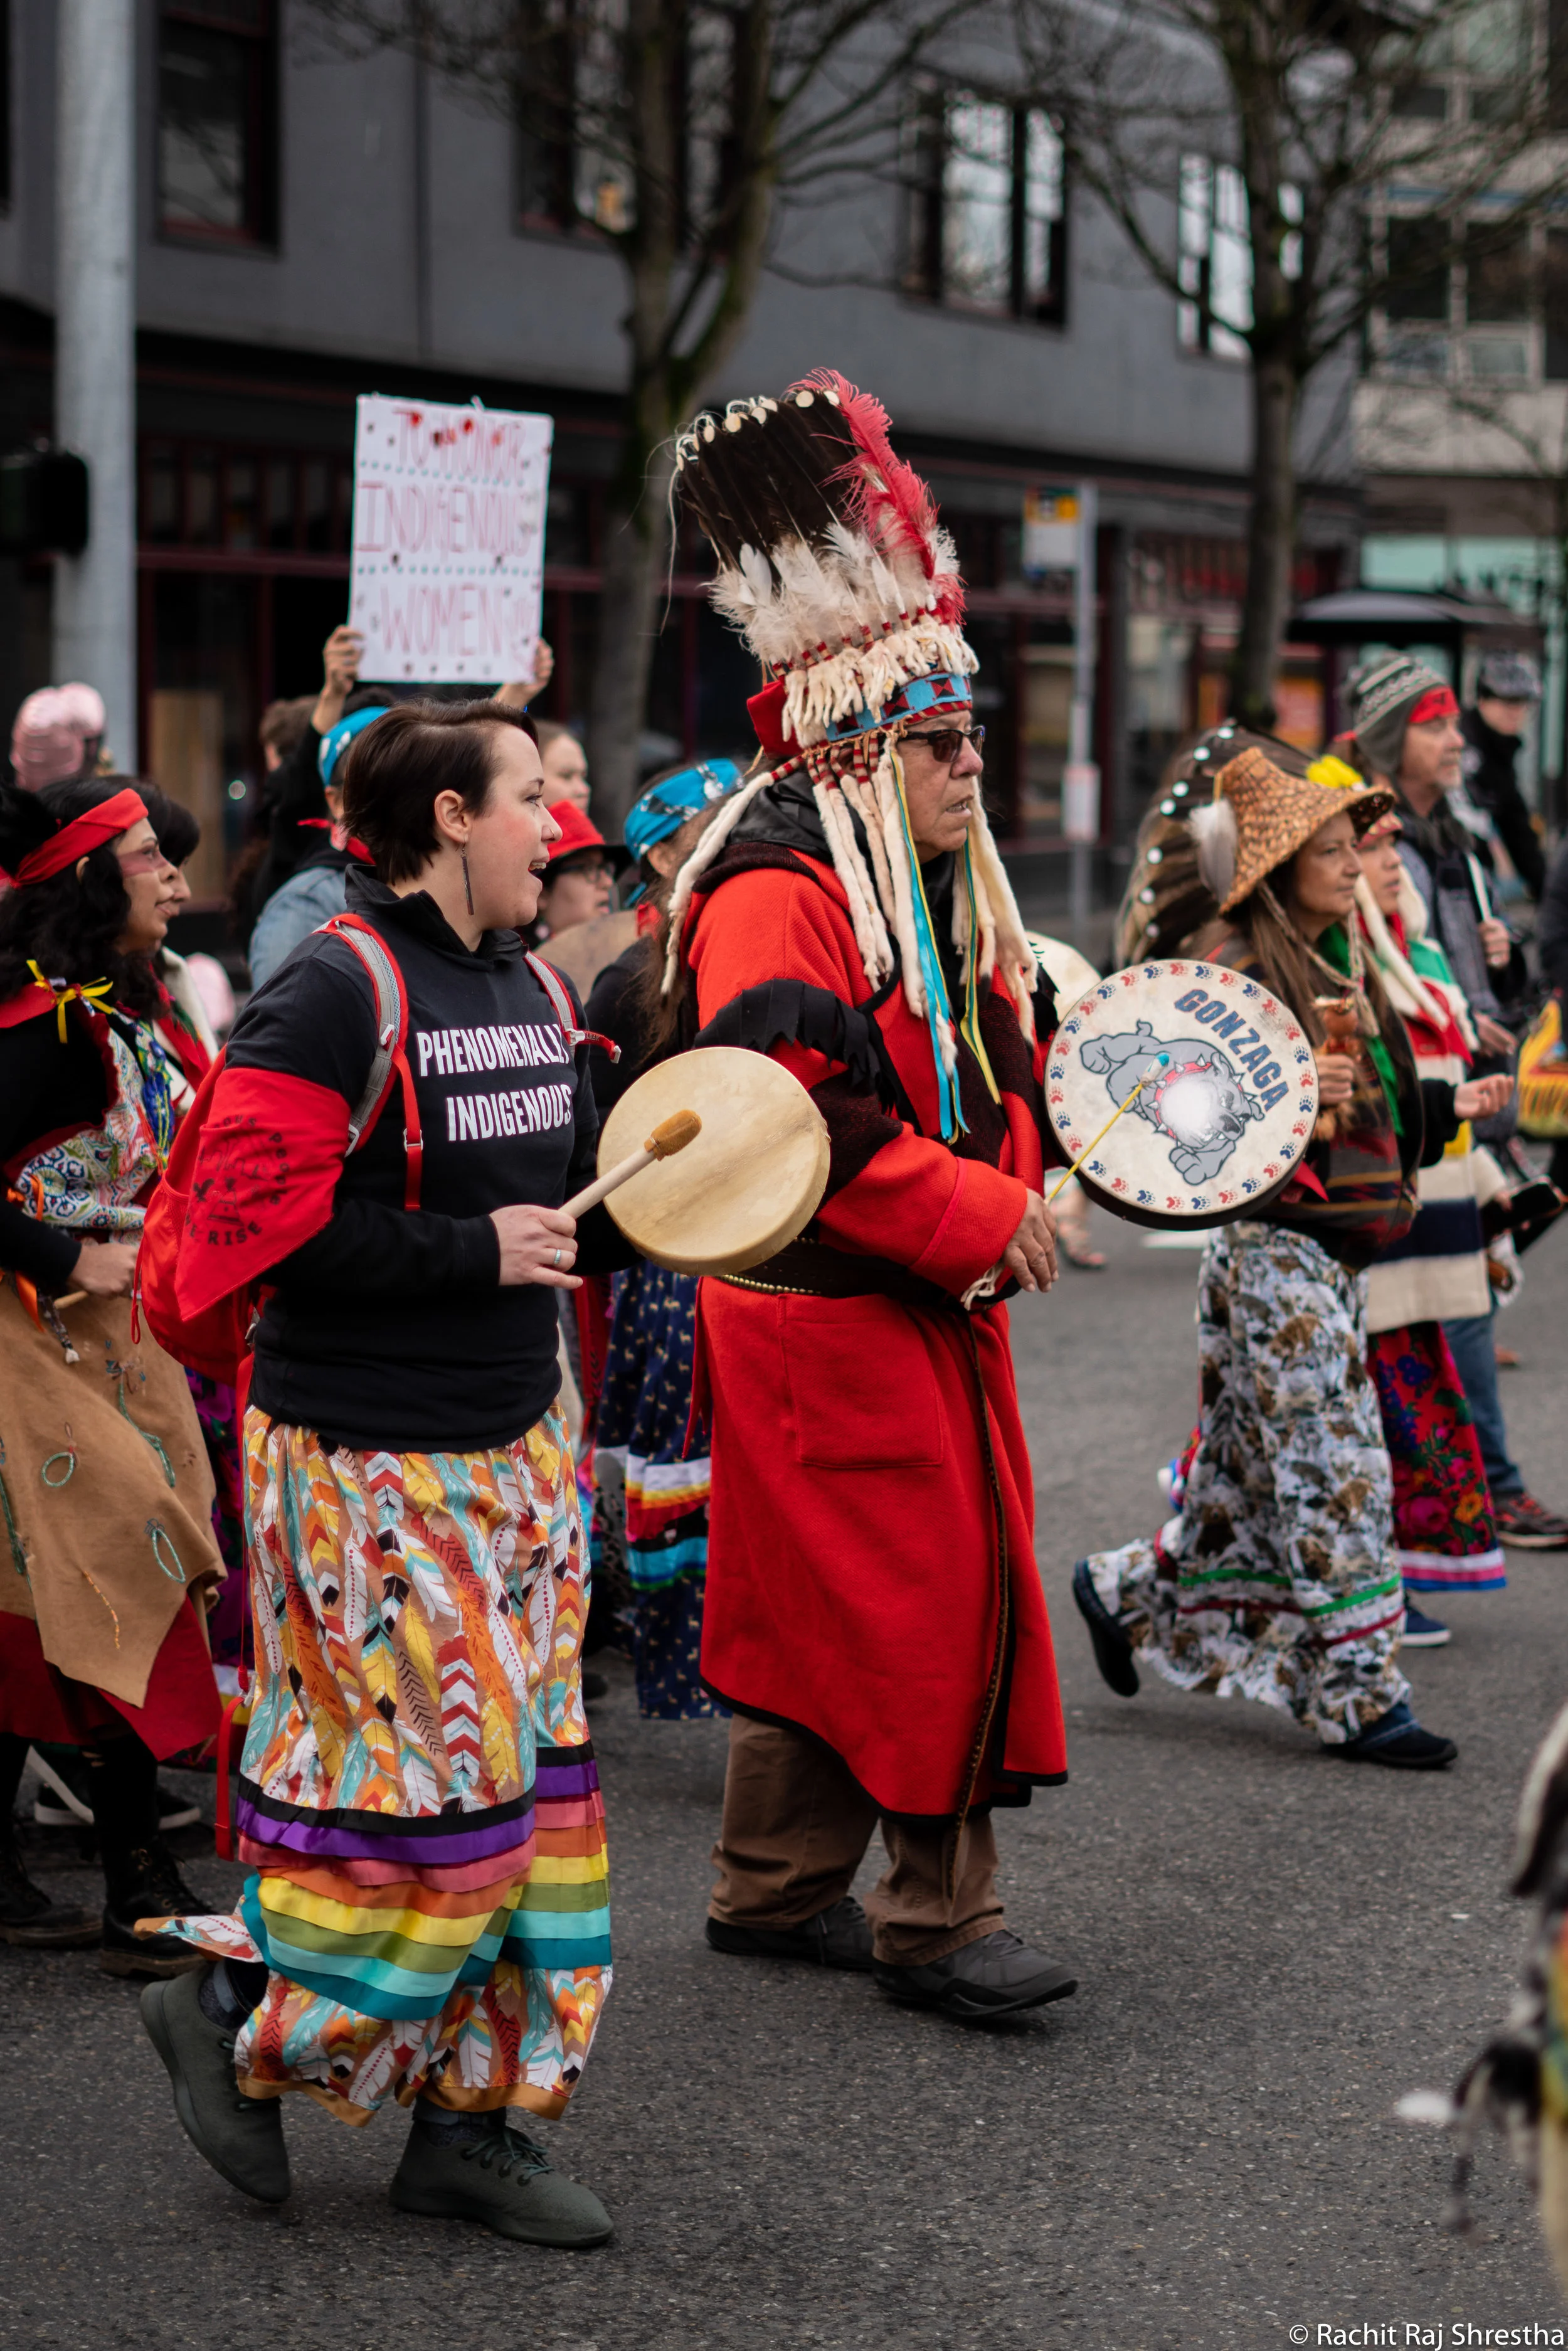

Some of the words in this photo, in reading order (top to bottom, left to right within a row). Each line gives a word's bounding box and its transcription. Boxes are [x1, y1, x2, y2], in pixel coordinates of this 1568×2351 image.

[393, 408, 431, 469] TO
[355, 481, 532, 558] INDIGENOUS
[380, 582, 502, 656] WOMEN
[1173, 989, 1290, 1112] GONZAGA
[446, 1084, 572, 1142] INDIGENOUS
[208, 1221, 262, 1246] RISE
